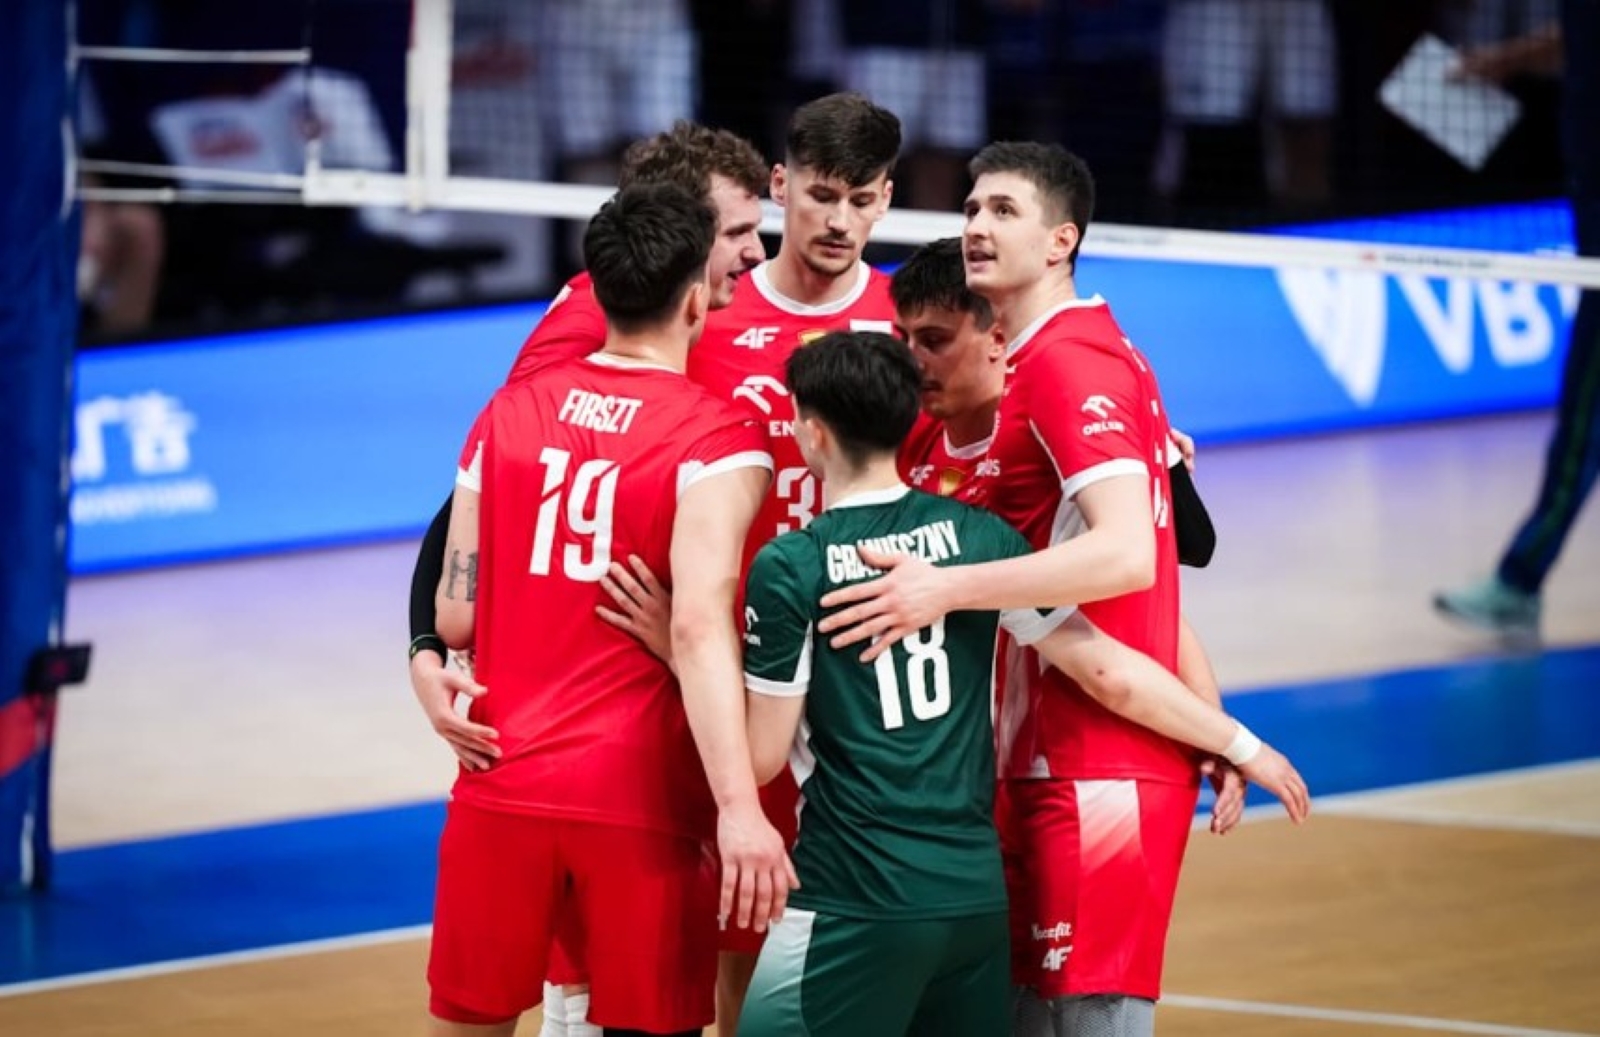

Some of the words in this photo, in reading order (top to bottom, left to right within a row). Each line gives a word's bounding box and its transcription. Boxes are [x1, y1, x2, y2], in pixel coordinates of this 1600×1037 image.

[733, 326, 781, 350] 4F
[558, 388, 644, 435] FIRSZT
[1082, 420, 1126, 436] ORLEN
[529, 447, 621, 582] 19
[827, 520, 961, 583] GRCZNY
[870, 614, 952, 731] 18
[1041, 945, 1073, 971] 4F
